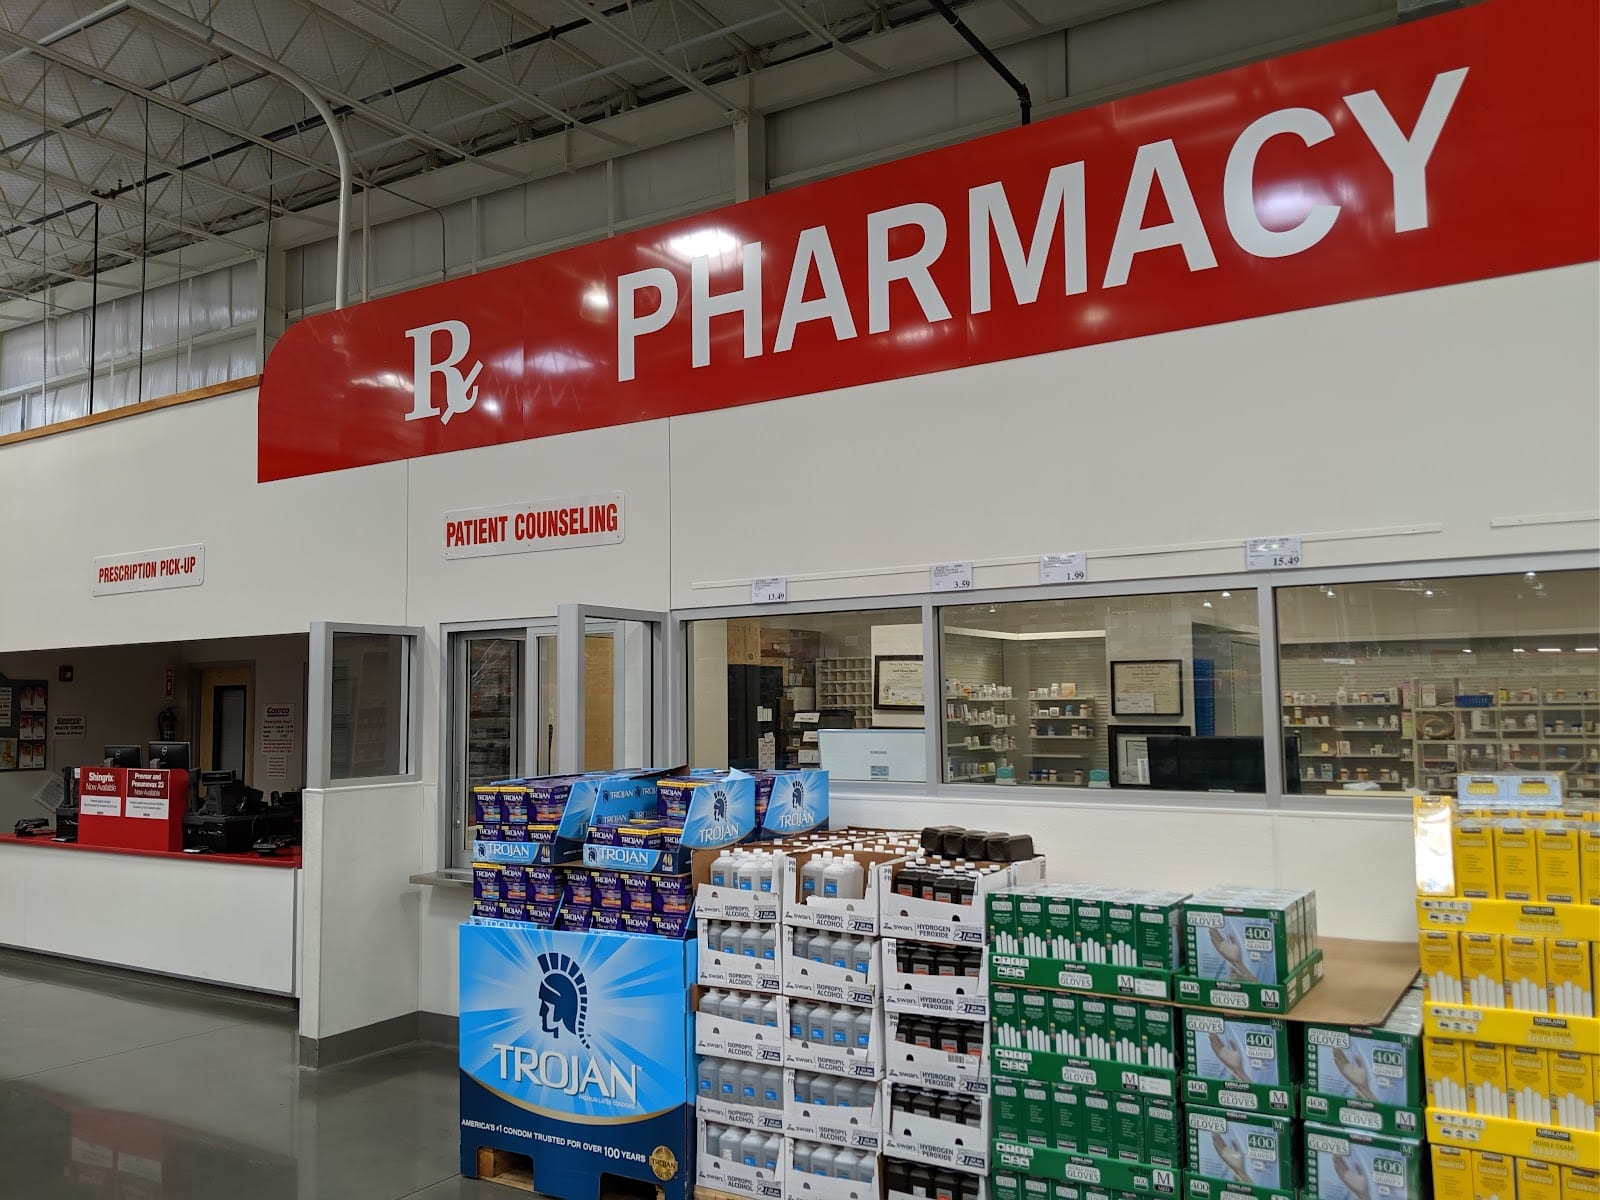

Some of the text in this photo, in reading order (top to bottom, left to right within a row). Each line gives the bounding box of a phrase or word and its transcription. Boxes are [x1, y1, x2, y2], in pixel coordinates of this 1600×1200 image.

[616, 66, 1470, 383] PHARMACY
[446, 503, 618, 548] PATIENT COUNSELING
[1273, 556, 1300, 567] 15.49
[98, 556, 196, 585] PRESCRIPTION PICK-UP
[1066, 571, 1085, 581] 1.99
[953, 580, 970, 590] 3.59
[767, 592, 785, 601] 13.49
[88, 772, 114, 784] Shingrix
[86, 783, 117, 792] Now Available
[131, 780, 157, 788] Pneumovax
[610, 790, 634, 799] TROJAN
[660, 788, 682, 797] TROJAN
[779, 812, 816, 829] TROJAN
[591, 831, 614, 840] TROJAN
[699, 823, 741, 843] TROJAN
[621, 836, 644, 845] TROJAN
[487, 843, 530, 857] TROJAN
[600, 847, 649, 865] TROJAN
[662, 853, 673, 866] 40
[476, 870, 496, 879] TROJAN
[501, 869, 522, 877] TROJAN
[529, 871, 551, 880] TROJAN
[567, 873, 588, 881] TROJAN
[594, 876, 617, 884] TROJAN
[624, 878, 647, 887] TROJAN
[656, 881, 680, 889] TROJAN
[477, 904, 497, 912] TROJAN
[503, 907, 523, 915] TROJAN
[529, 909, 551, 918] TROJAN
[563, 913, 585, 921] TROJAN
[816, 914, 844, 922] ISOPROPYL
[596, 916, 618, 925] TROJAN
[625, 918, 649, 928] TROJAN
[656, 921, 680, 930] TROJAN
[817, 920, 844, 929] ALCOHOL
[1188, 916, 1224, 927] GLOVES
[917, 924, 951, 933] HYDROGEN
[919, 930, 949, 939] PEROXIDE
[1246, 928, 1271, 940] 400
[728, 972, 753, 980] ISOPROPYL
[1060, 977, 1092, 988] GLOVES
[1120, 977, 1131, 986] M
[816, 984, 844, 992] ISOPROPYL
[1181, 983, 1200, 992] 400
[817, 991, 844, 999] ALCOHOL
[1264, 990, 1277, 1000] M
[920, 997, 954, 1005] HYDROGEN
[1212, 996, 1248, 1007] GLOVES
[922, 1003, 953, 1011] PEROXIDE
[1187, 1021, 1223, 1032] GLOVES
[1247, 1034, 1273, 1047] 400
[1309, 1035, 1349, 1047] GLOVES
[727, 1042, 753, 1050] ISOPROPYL
[728, 1048, 753, 1057] ALCOHOL
[817, 1056, 845, 1066] ISOPROPYL
[1374, 1051, 1402, 1065] 400
[818, 1063, 845, 1073] ALCOHOL
[492, 1043, 637, 1106] TROJAN
[922, 1072, 956, 1082] HYDROGEN
[1064, 1073, 1095, 1084] GLOVES
[1124, 1073, 1136, 1084] M
[925, 1079, 955, 1088] PEROXIDE
[1188, 1082, 1207, 1092] 400
[1220, 1095, 1257, 1108] GLOVES
[1271, 1092, 1285, 1103] M
[1307, 1098, 1328, 1108] 400
[728, 1109, 754, 1118] ISOPROPYL
[728, 1115, 754, 1124] ALCOHOL
[1341, 1114, 1380, 1128] GLOVES
[1398, 1113, 1413, 1125] M
[1190, 1119, 1226, 1131] GLOVES
[818, 1126, 848, 1136] ISOPROPYL
[461, 1118, 646, 1163] AMERICA'S #1 CONDOM TRUSTED FOR OVER 100 YEARS
[819, 1133, 848, 1143] ALCOHOL
[1248, 1135, 1275, 1149] 400
[920, 1144, 954, 1155] HYDROGEN
[1309, 1141, 1349, 1154] GLOVES
[922, 1151, 952, 1161] PEROXIDE
[652, 1158, 676, 1170] TROJAN
[1374, 1159, 1402, 1173] 400
[727, 1175, 753, 1186] ISOPROPYL
[1067, 1170, 1099, 1181] GLOVES
[1156, 1171, 1170, 1185] M
[728, 1181, 753, 1192] ALCOHOL
[1191, 1182, 1209, 1192] 400
